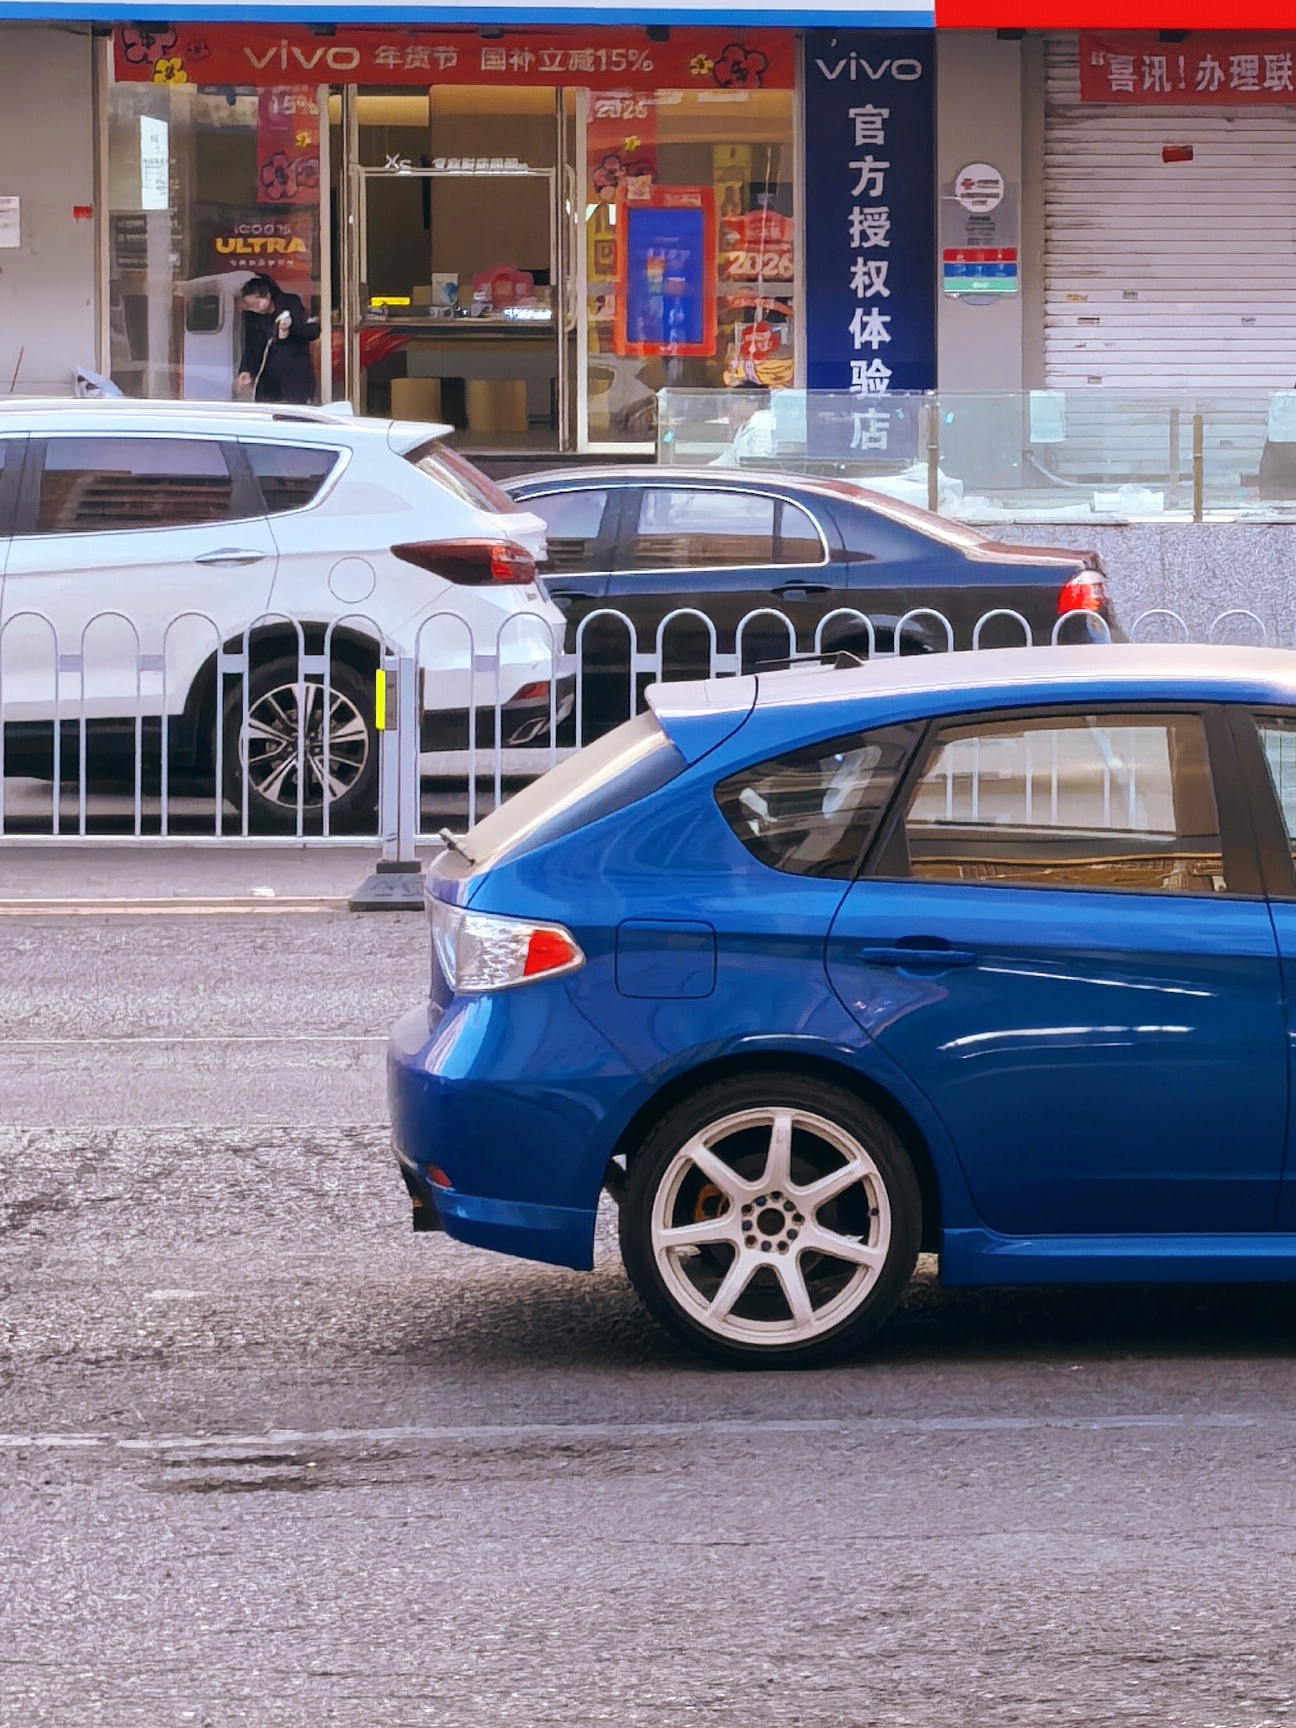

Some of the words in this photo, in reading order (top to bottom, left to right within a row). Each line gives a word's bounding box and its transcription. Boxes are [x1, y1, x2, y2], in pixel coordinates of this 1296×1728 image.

[243, 39, 361, 71] vivo
[374, 45, 459, 70] 年货节
[815, 52, 922, 81] vivo
[215, 237, 307, 254] ULTRA
[727, 250, 793, 278] 2026
[848, 103, 892, 451] 官方授权体验店
